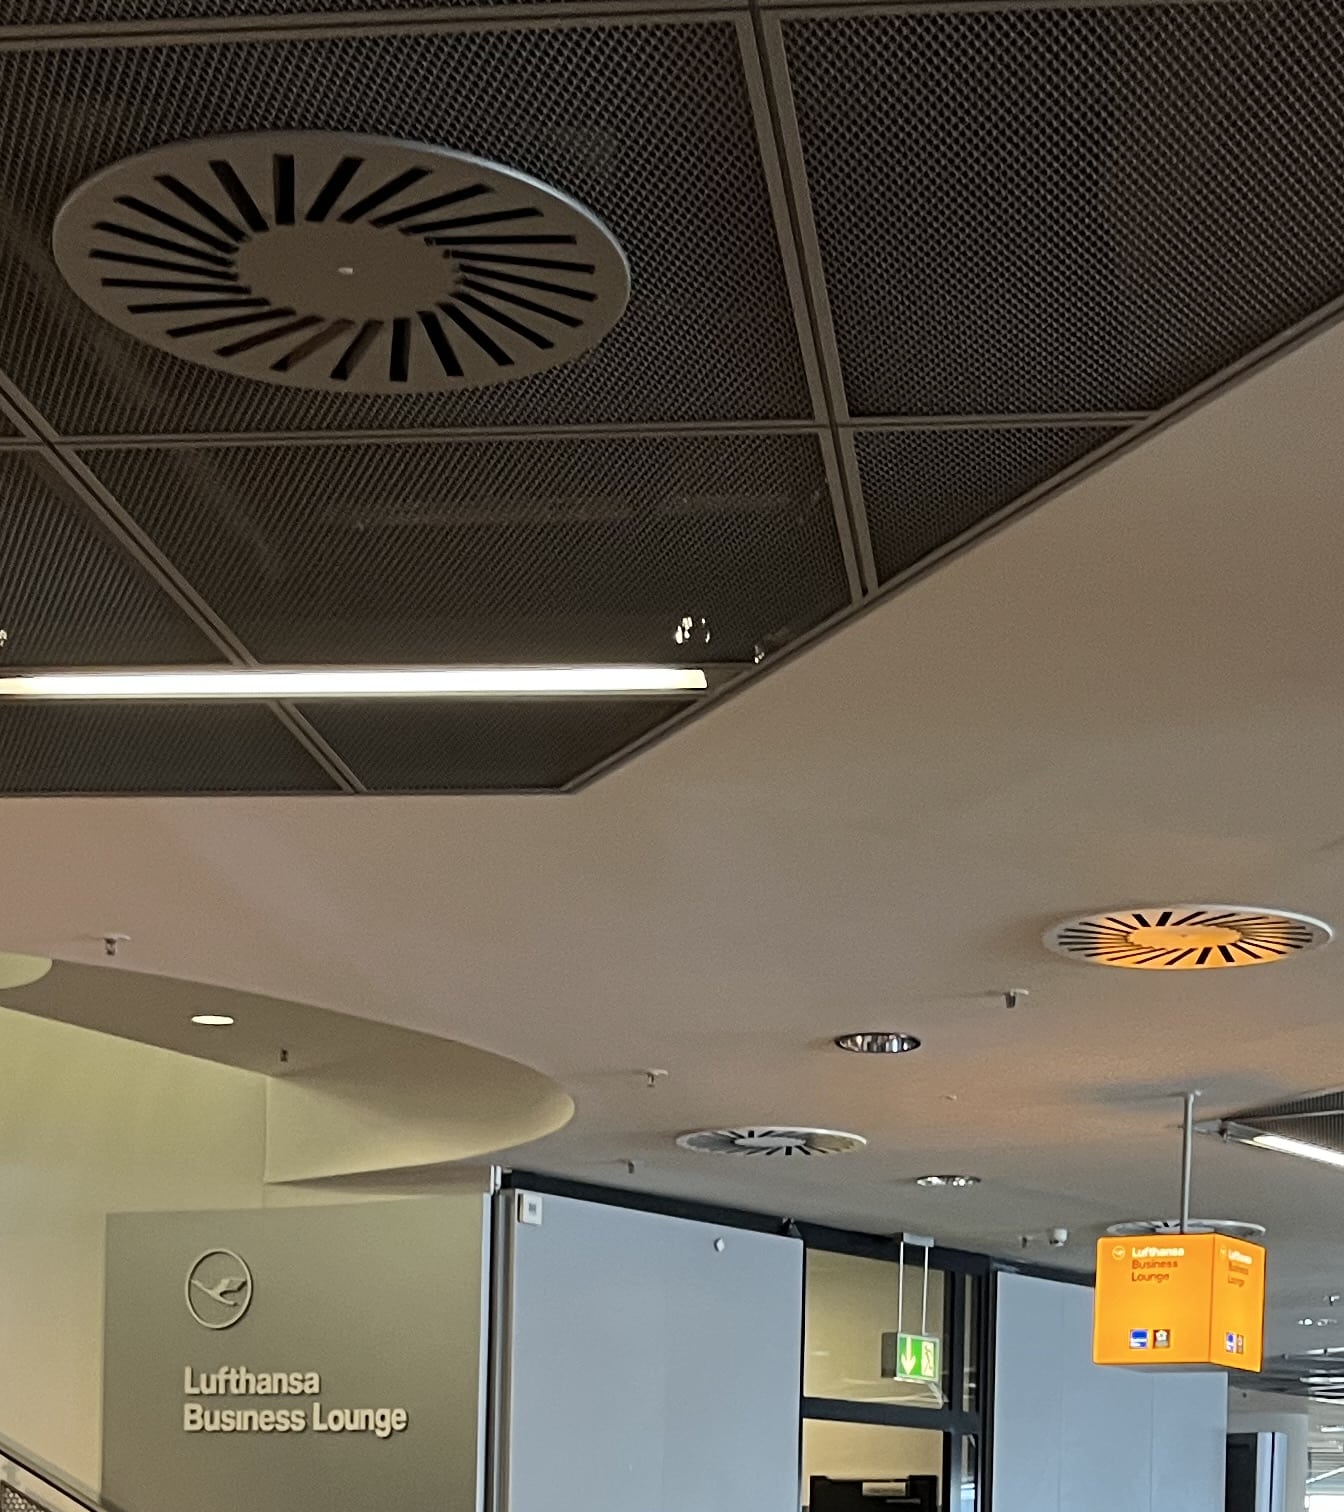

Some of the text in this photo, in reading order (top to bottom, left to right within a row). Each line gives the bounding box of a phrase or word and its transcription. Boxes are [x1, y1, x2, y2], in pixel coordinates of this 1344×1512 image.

[1131, 1259, 1178, 1270] Business
[1131, 1272, 1170, 1284] Lounge
[183, 1366, 321, 1395] Lufthansa
[183, 1402, 408, 1439] Business Lounge
